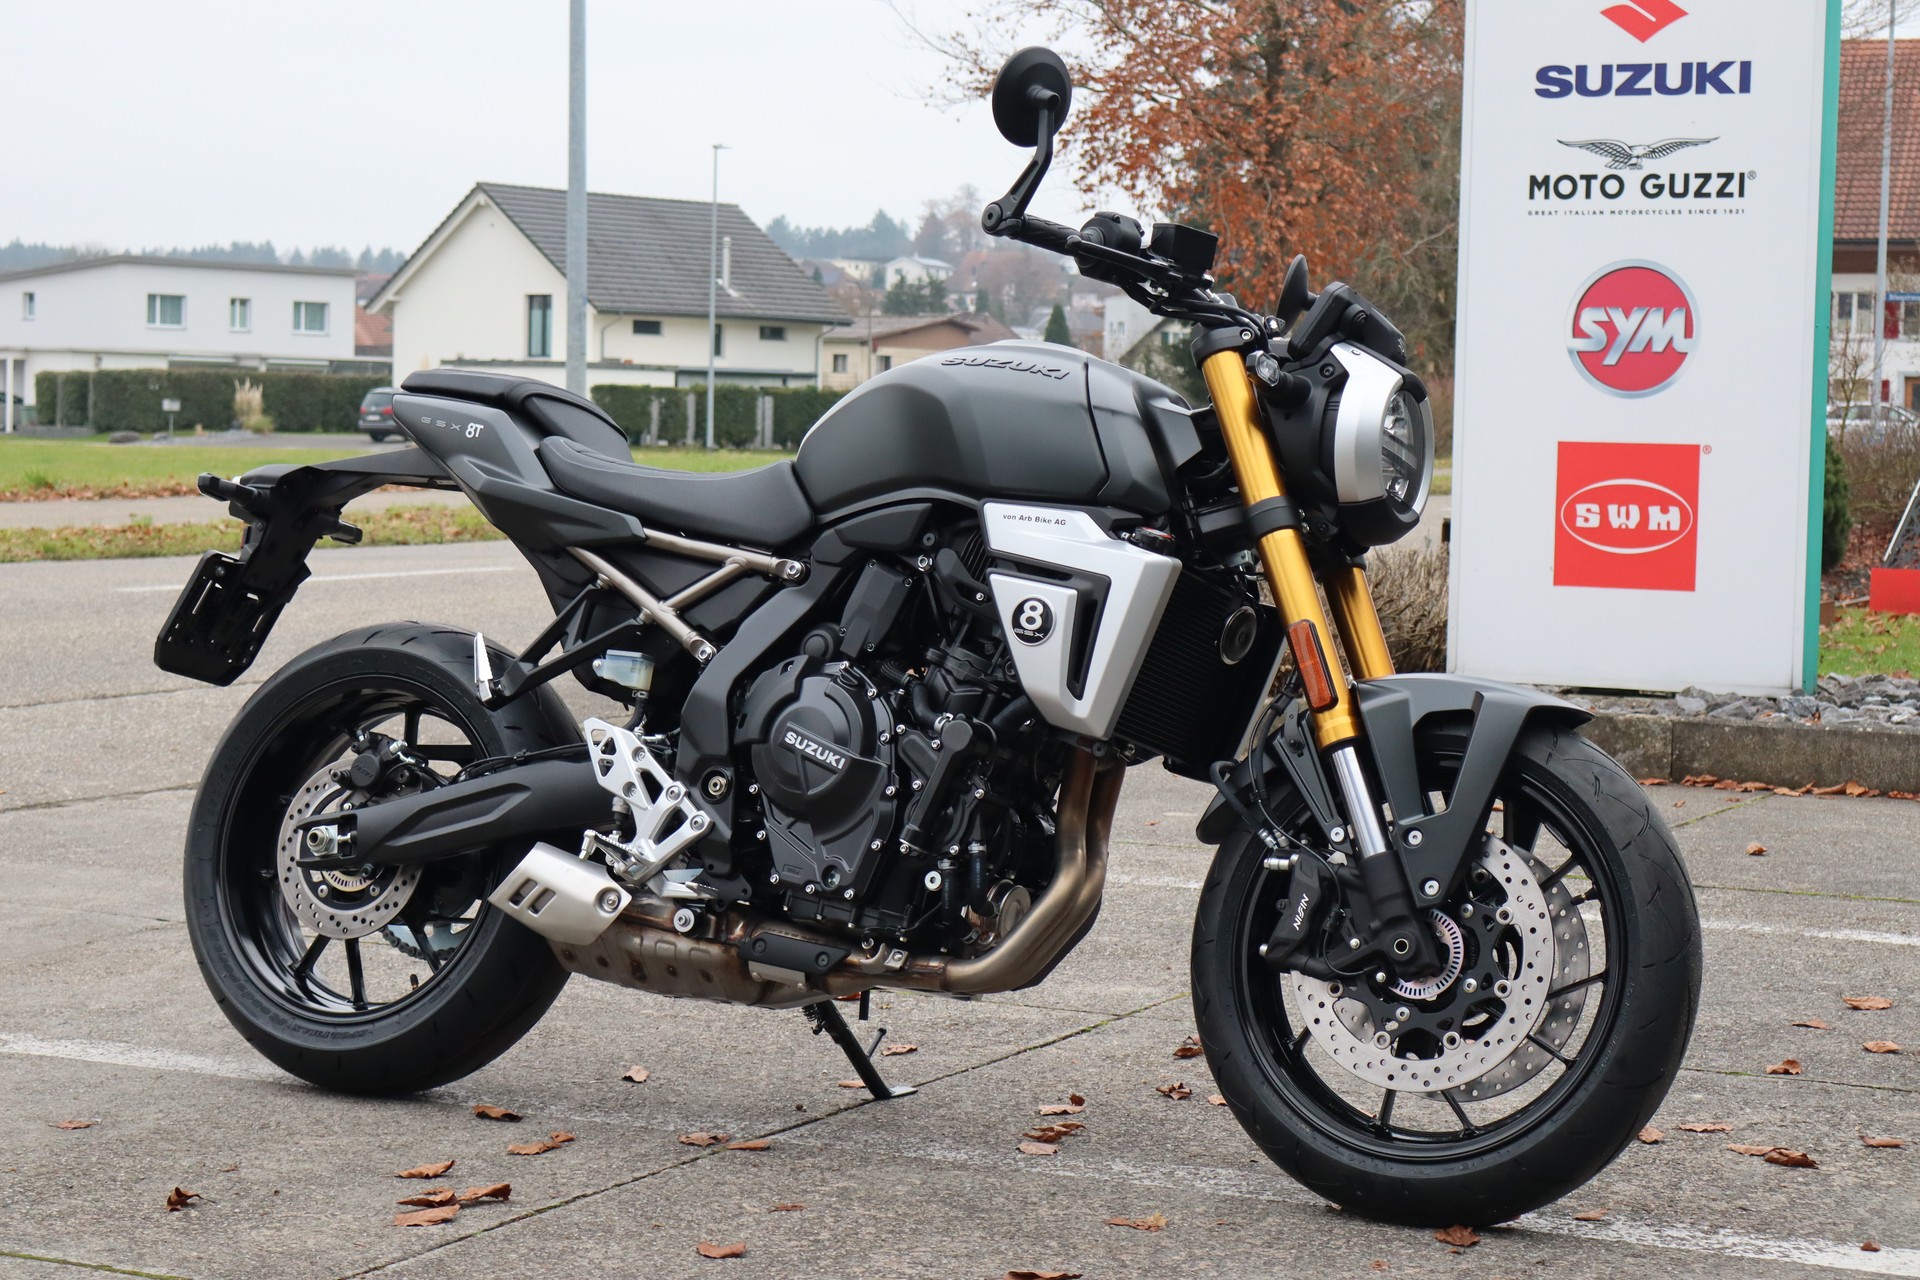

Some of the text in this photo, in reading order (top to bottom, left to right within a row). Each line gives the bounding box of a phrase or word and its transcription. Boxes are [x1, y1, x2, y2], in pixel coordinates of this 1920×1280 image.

[1534, 60, 1752, 99] SUZUKI
[1528, 172, 1745, 200] MOTO GUZZI
[1568, 306, 1694, 366] SYM
[941, 357, 1071, 380] SUZUKI
[465, 422, 484, 439] 8T
[1018, 514, 1033, 522] Arb
[1034, 516, 1052, 525] Bike
[1054, 518, 1067, 526] AG
[1575, 503, 1681, 532] SWM
[1019, 599, 1044, 630] 8
[784, 731, 846, 770] SUZUKI
